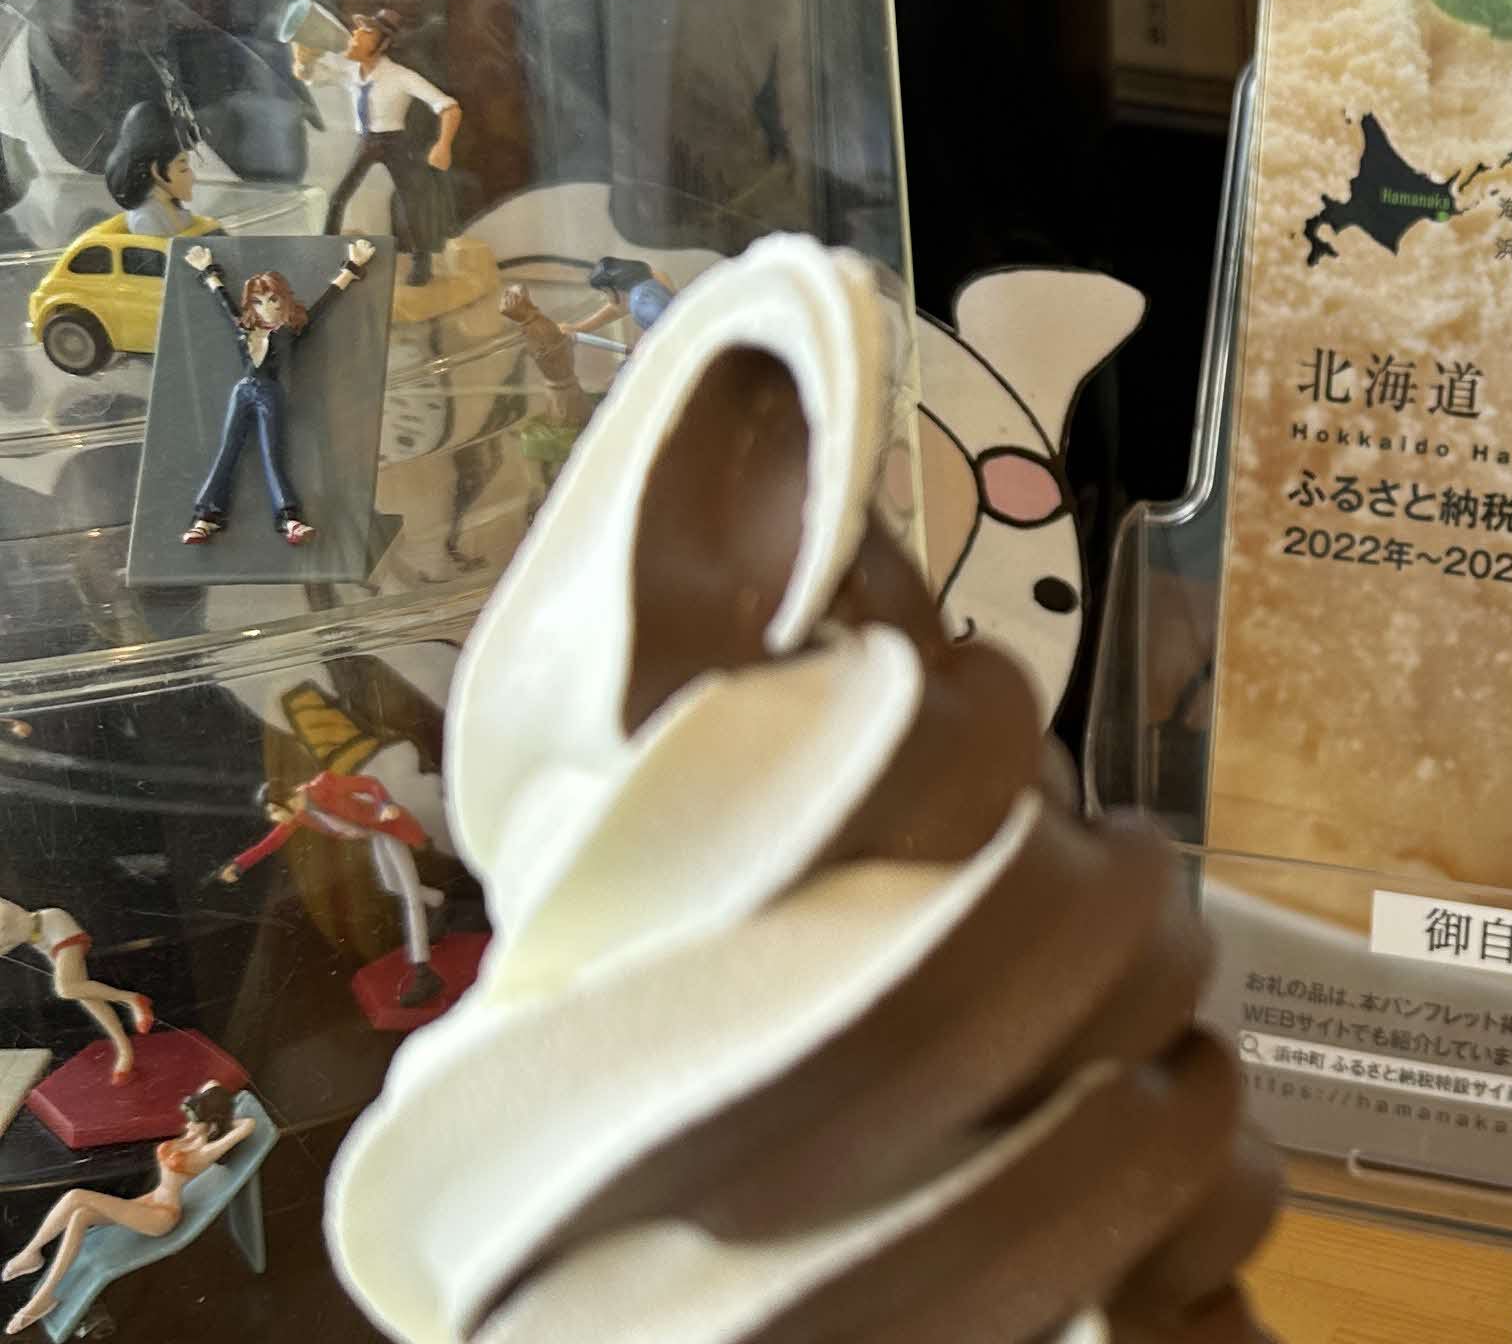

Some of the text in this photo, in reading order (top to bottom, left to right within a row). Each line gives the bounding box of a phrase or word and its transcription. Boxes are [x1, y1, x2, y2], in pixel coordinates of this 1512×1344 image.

[1297, 348, 1484, 421] 北海道
[1291, 423, 1450, 459] Hokkaido
